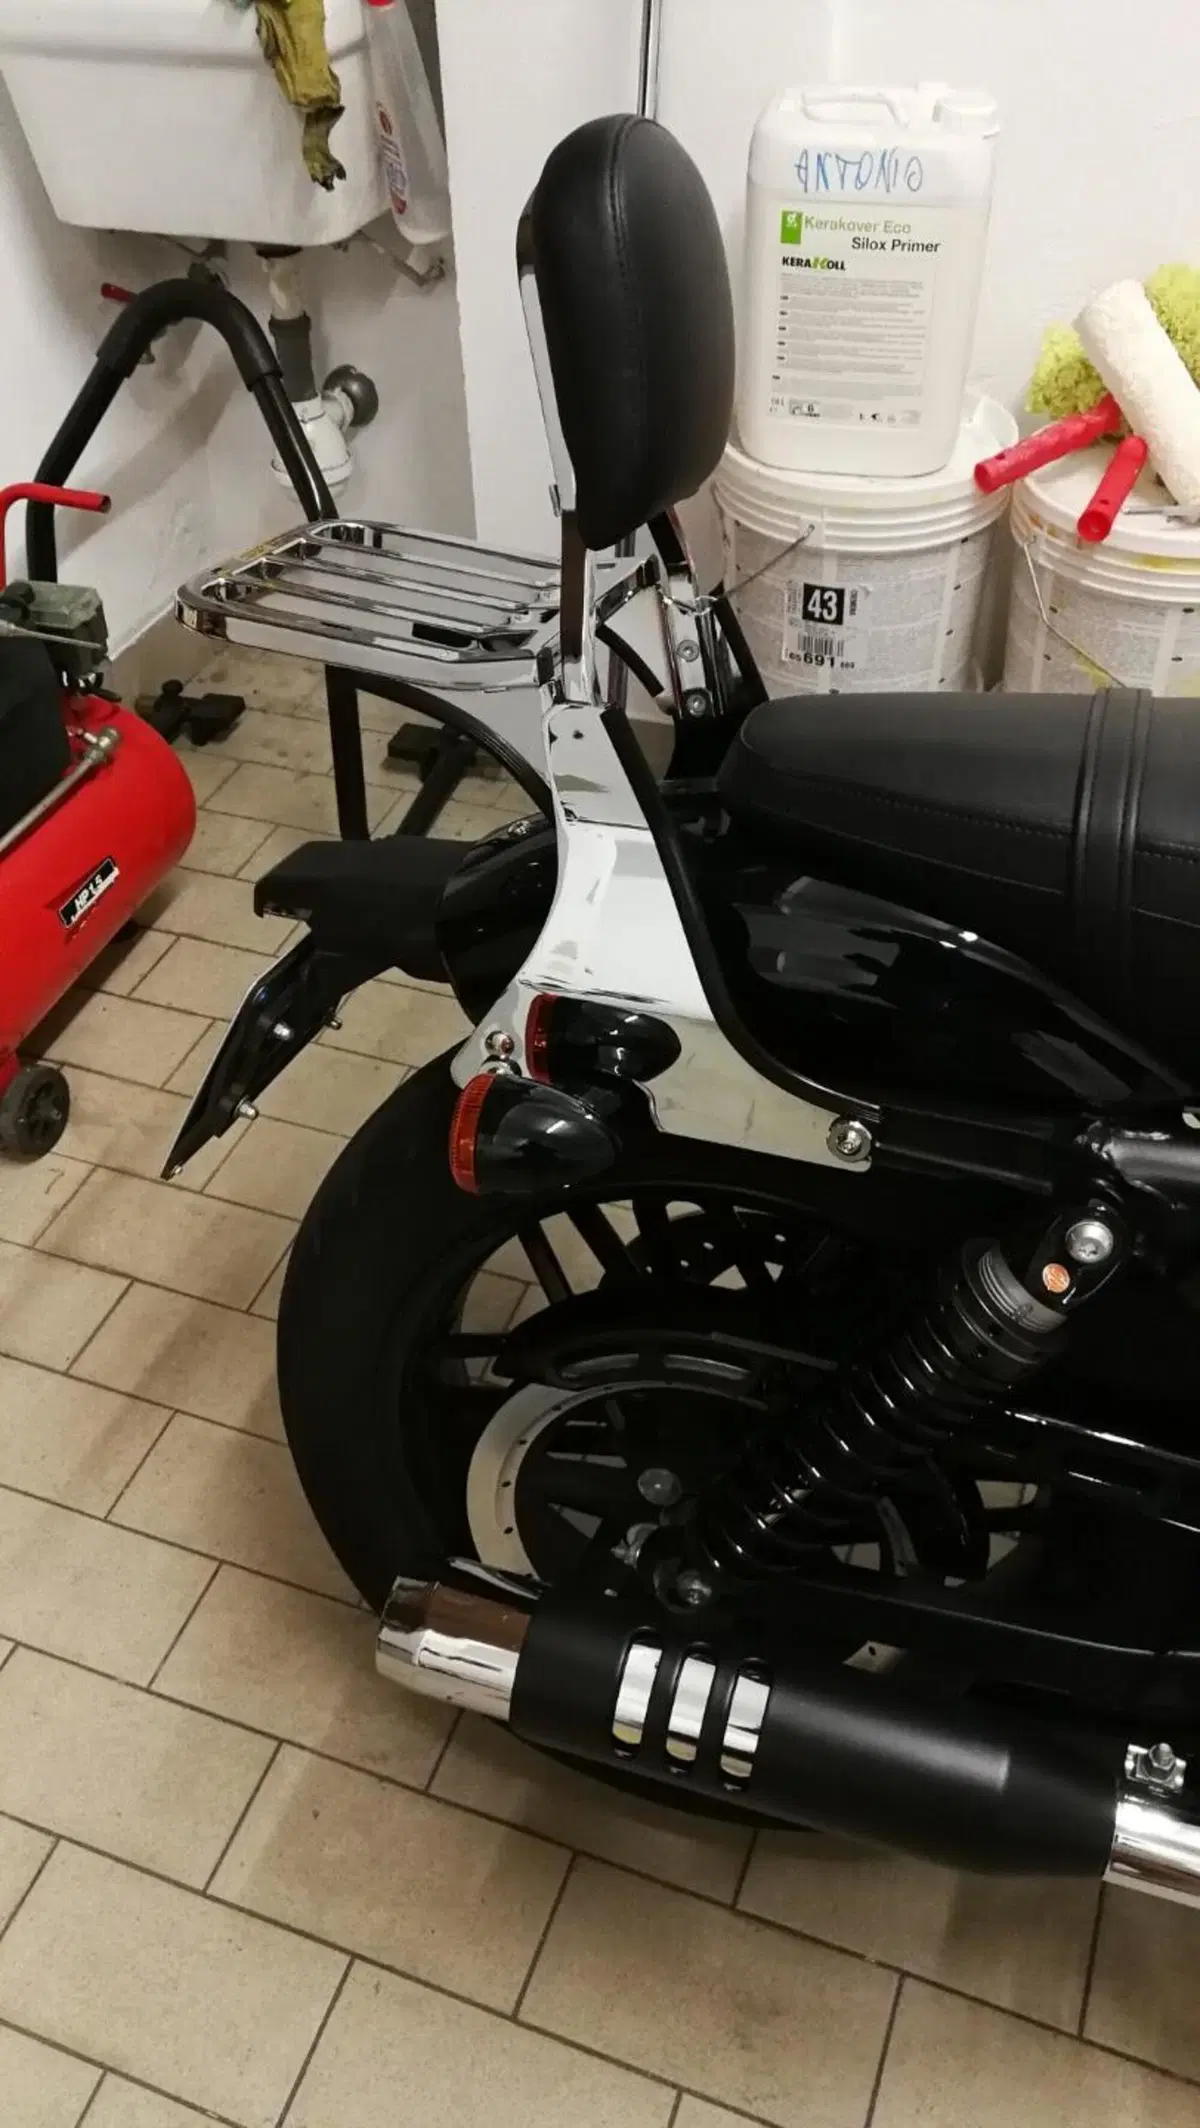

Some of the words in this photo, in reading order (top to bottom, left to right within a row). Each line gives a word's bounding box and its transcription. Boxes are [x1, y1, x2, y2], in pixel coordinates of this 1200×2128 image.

[794, 148, 924, 194] ANTONIO
[804, 215, 879, 233] Kerakover
[883, 219, 912, 235] Eco
[851, 236, 887, 251] Silox
[890, 238, 942, 253] Primer
[807, 588, 838, 621] 43
[803, 651, 835, 669] 691
